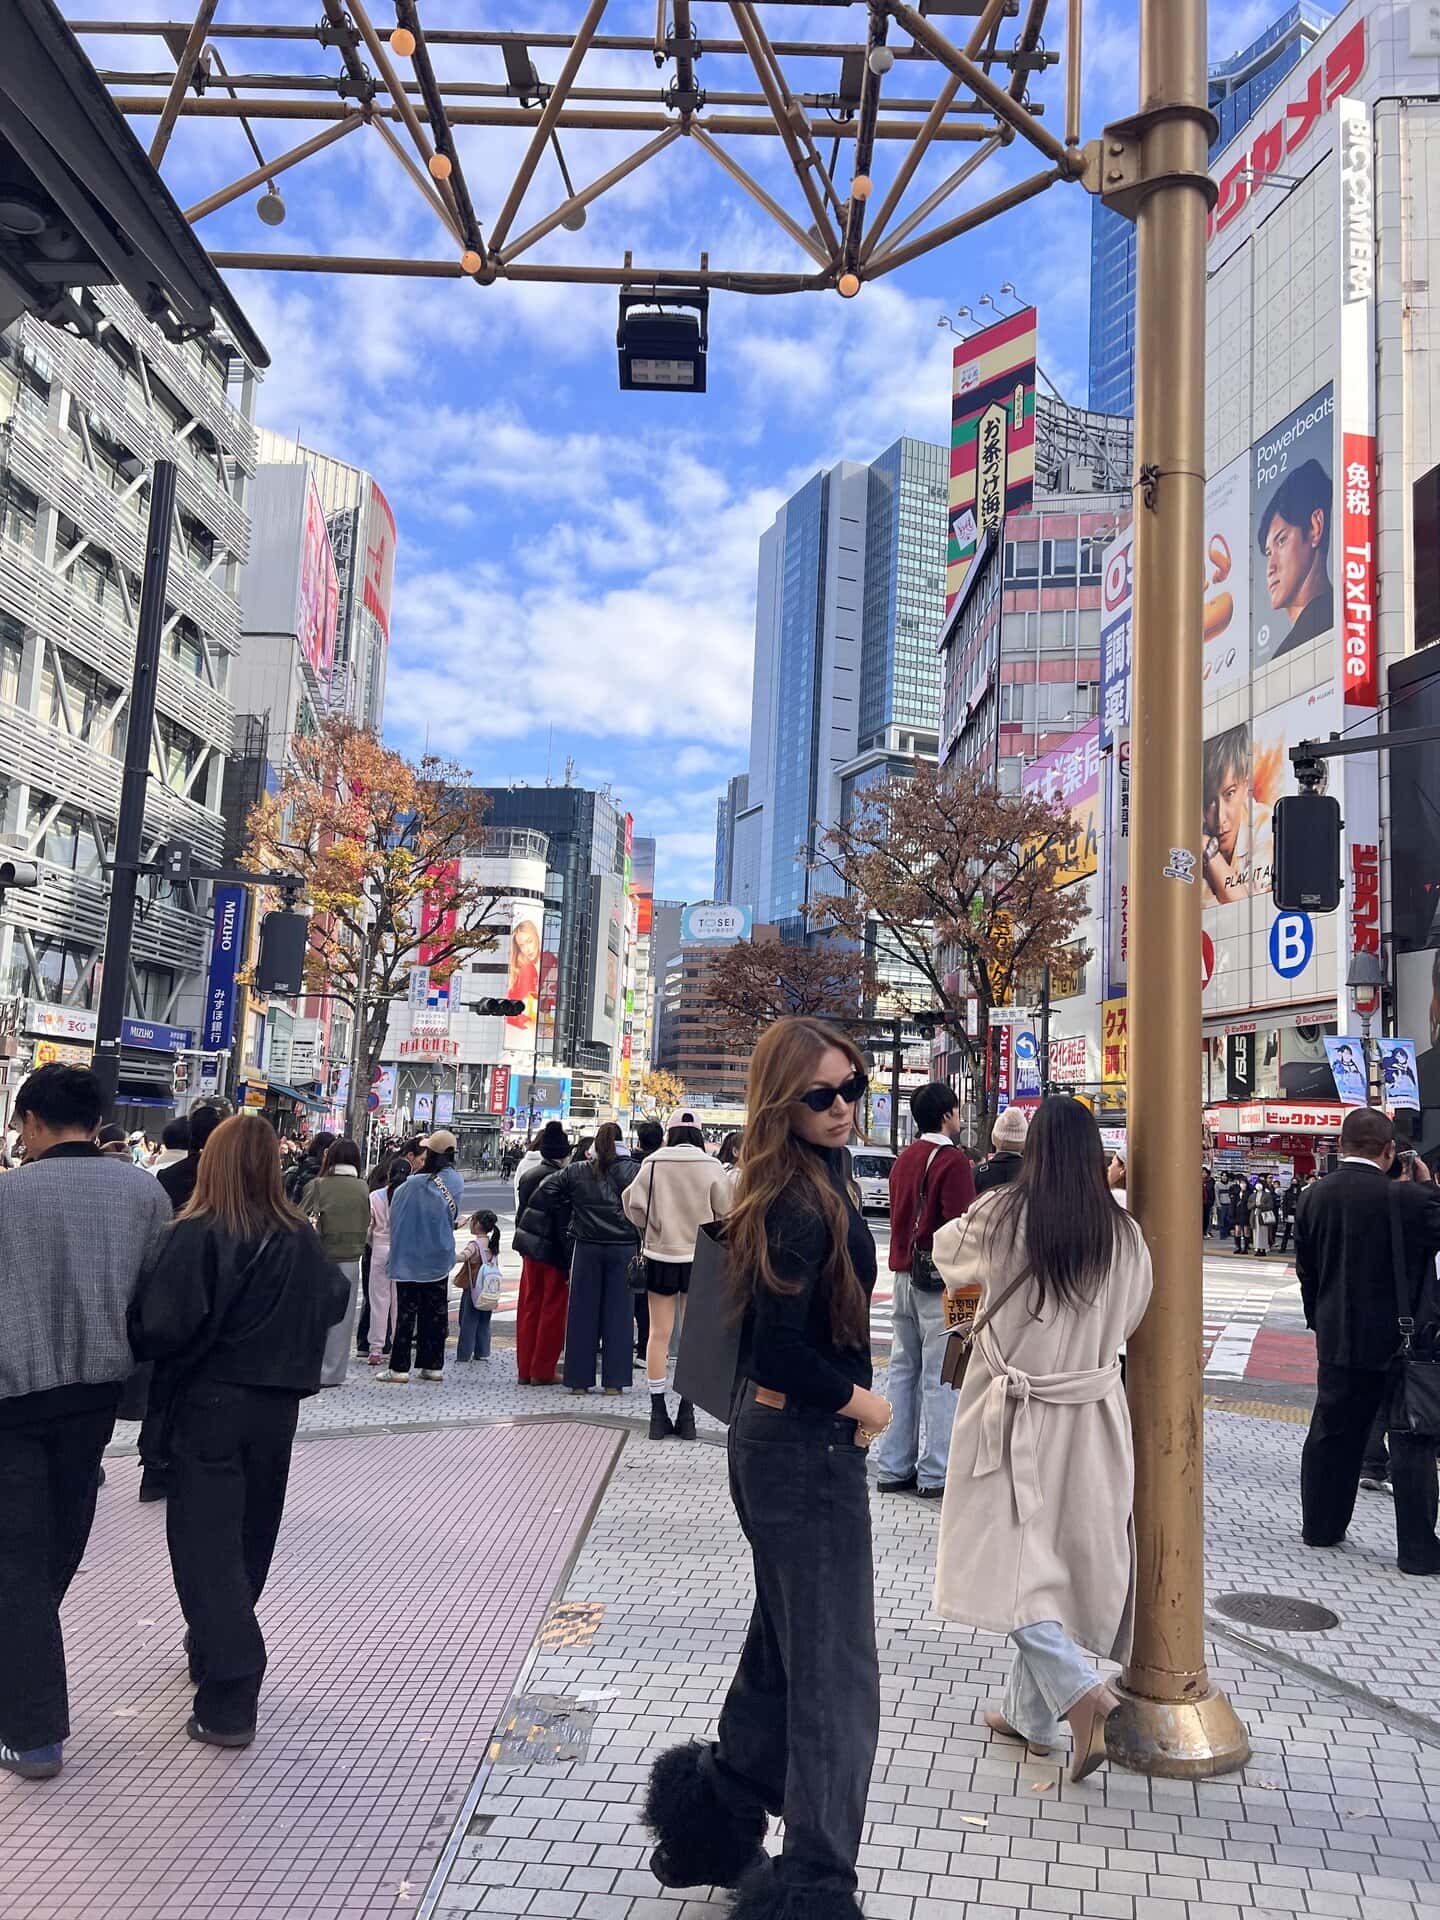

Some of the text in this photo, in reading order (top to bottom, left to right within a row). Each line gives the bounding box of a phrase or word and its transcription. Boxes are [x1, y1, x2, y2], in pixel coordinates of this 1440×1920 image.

[1350, 119, 1371, 299] BICCAMERA
[1257, 396, 1334, 467] Powerbeats
[1257, 452, 1288, 489] Pro 2
[1346, 463, 1371, 677] 免税 TaxFree
[1225, 868, 1248, 889] PLAY
[1253, 867, 1263, 882] IT
[221, 901, 236, 950] MIZUHO
[1278, 915, 1305, 970] B
[130, 1026, 154, 1040] MIZUHO
[210, 989, 226, 1044] みずほ銀行
[400, 1037, 460, 1056] MAGNET
[1058, 1039, 1086, 1067] 化粧品
[1235, 1035, 1247, 1084] ASUS
[1058, 1067, 1086, 1080] Cosmetics
[1266, 1111, 1342, 1127] ビックカメラ
